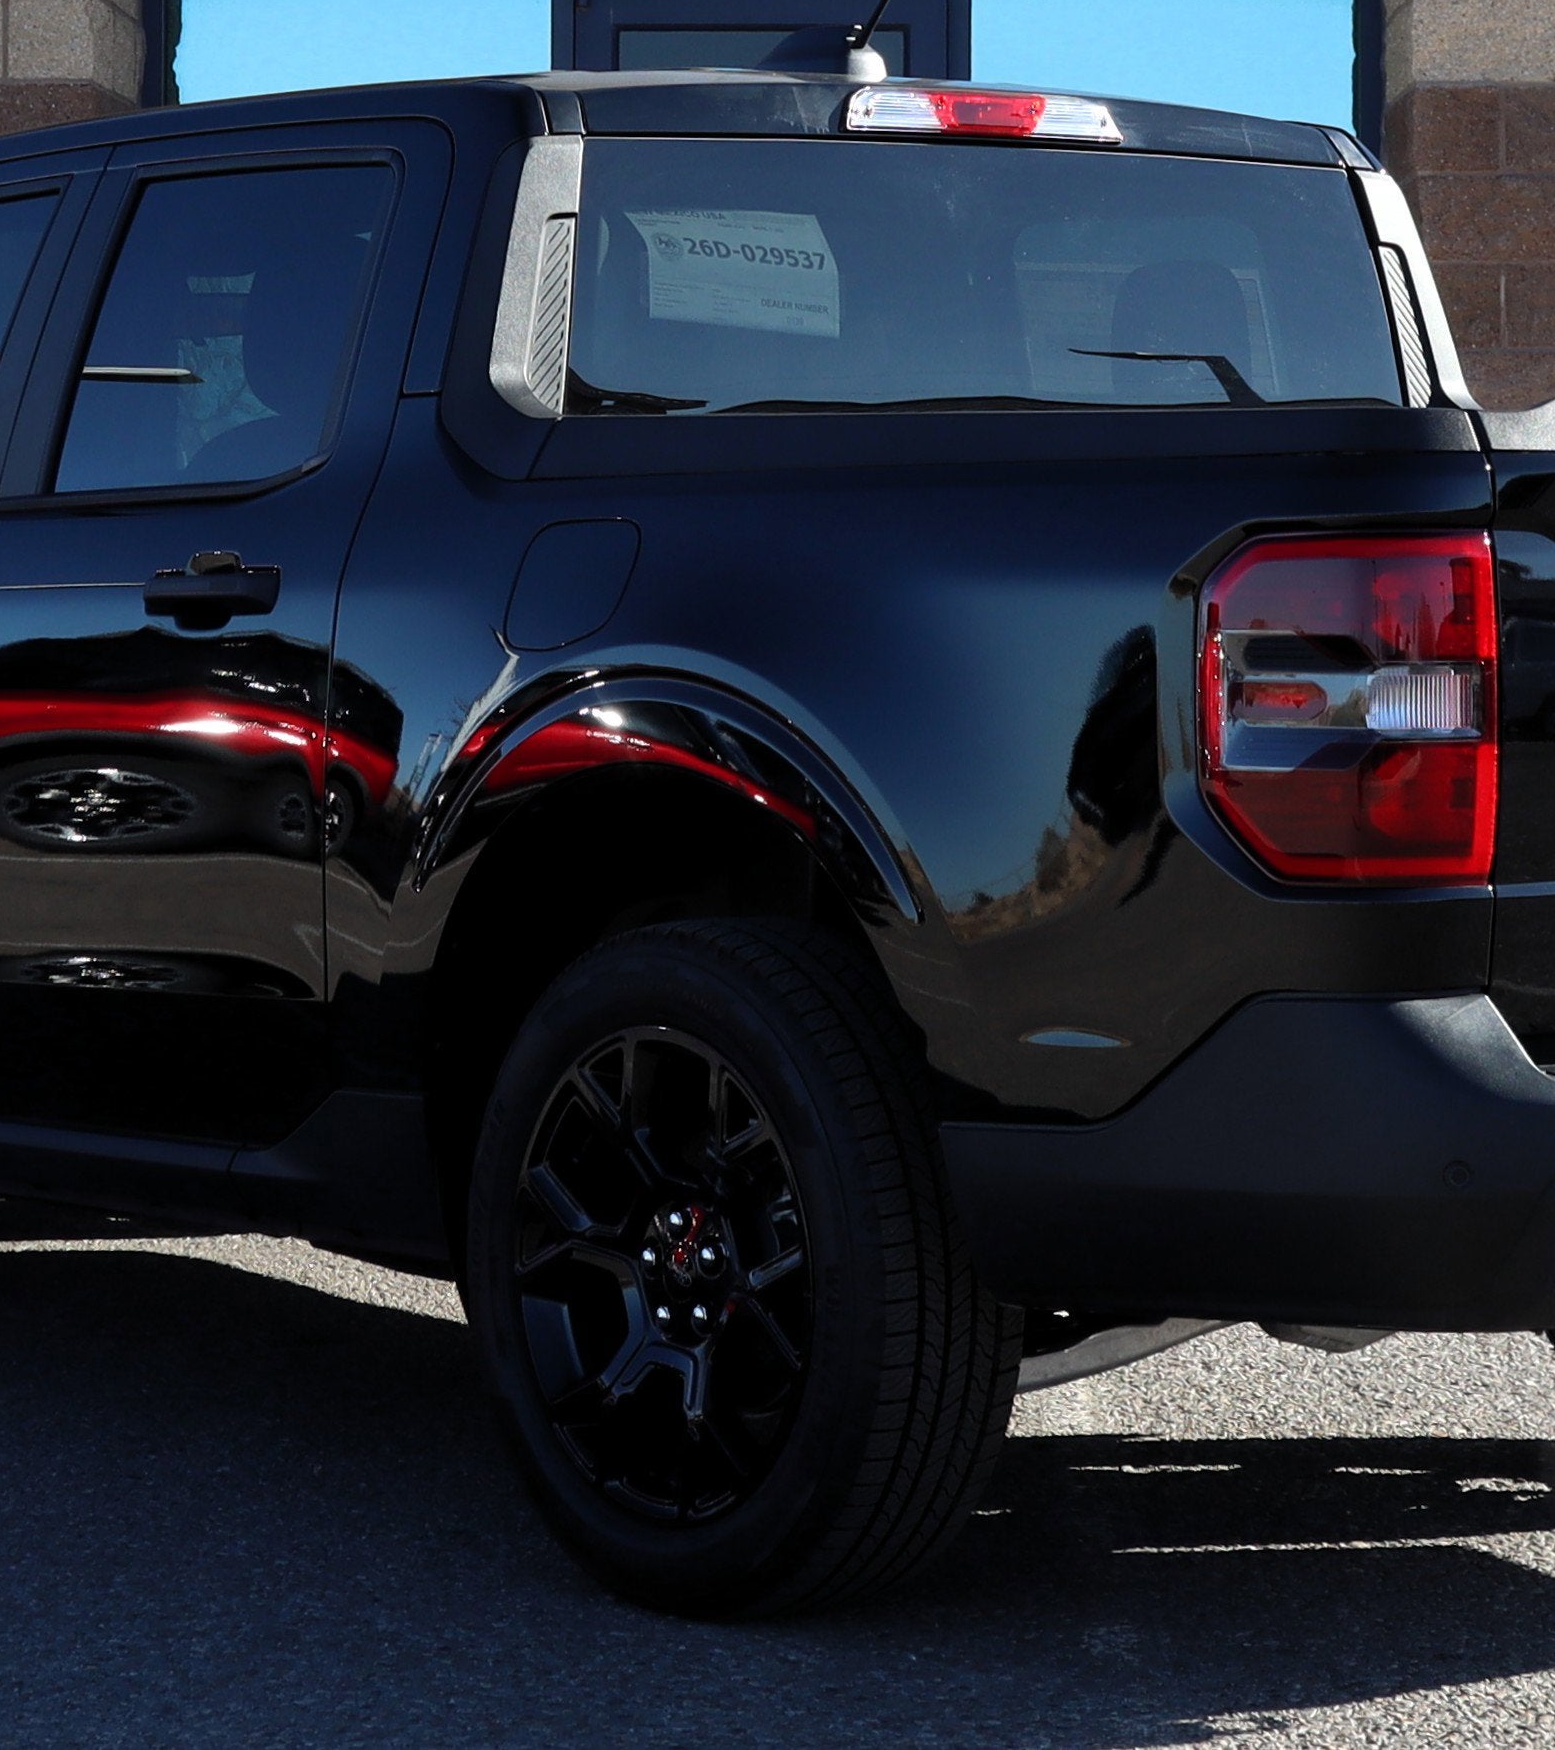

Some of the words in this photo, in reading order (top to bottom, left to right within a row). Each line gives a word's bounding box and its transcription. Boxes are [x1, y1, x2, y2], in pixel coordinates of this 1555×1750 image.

[683, 237, 826, 271] 26D-029537
[760, 298, 794, 310] DEALER
[794, 302, 830, 315] NUMBER
